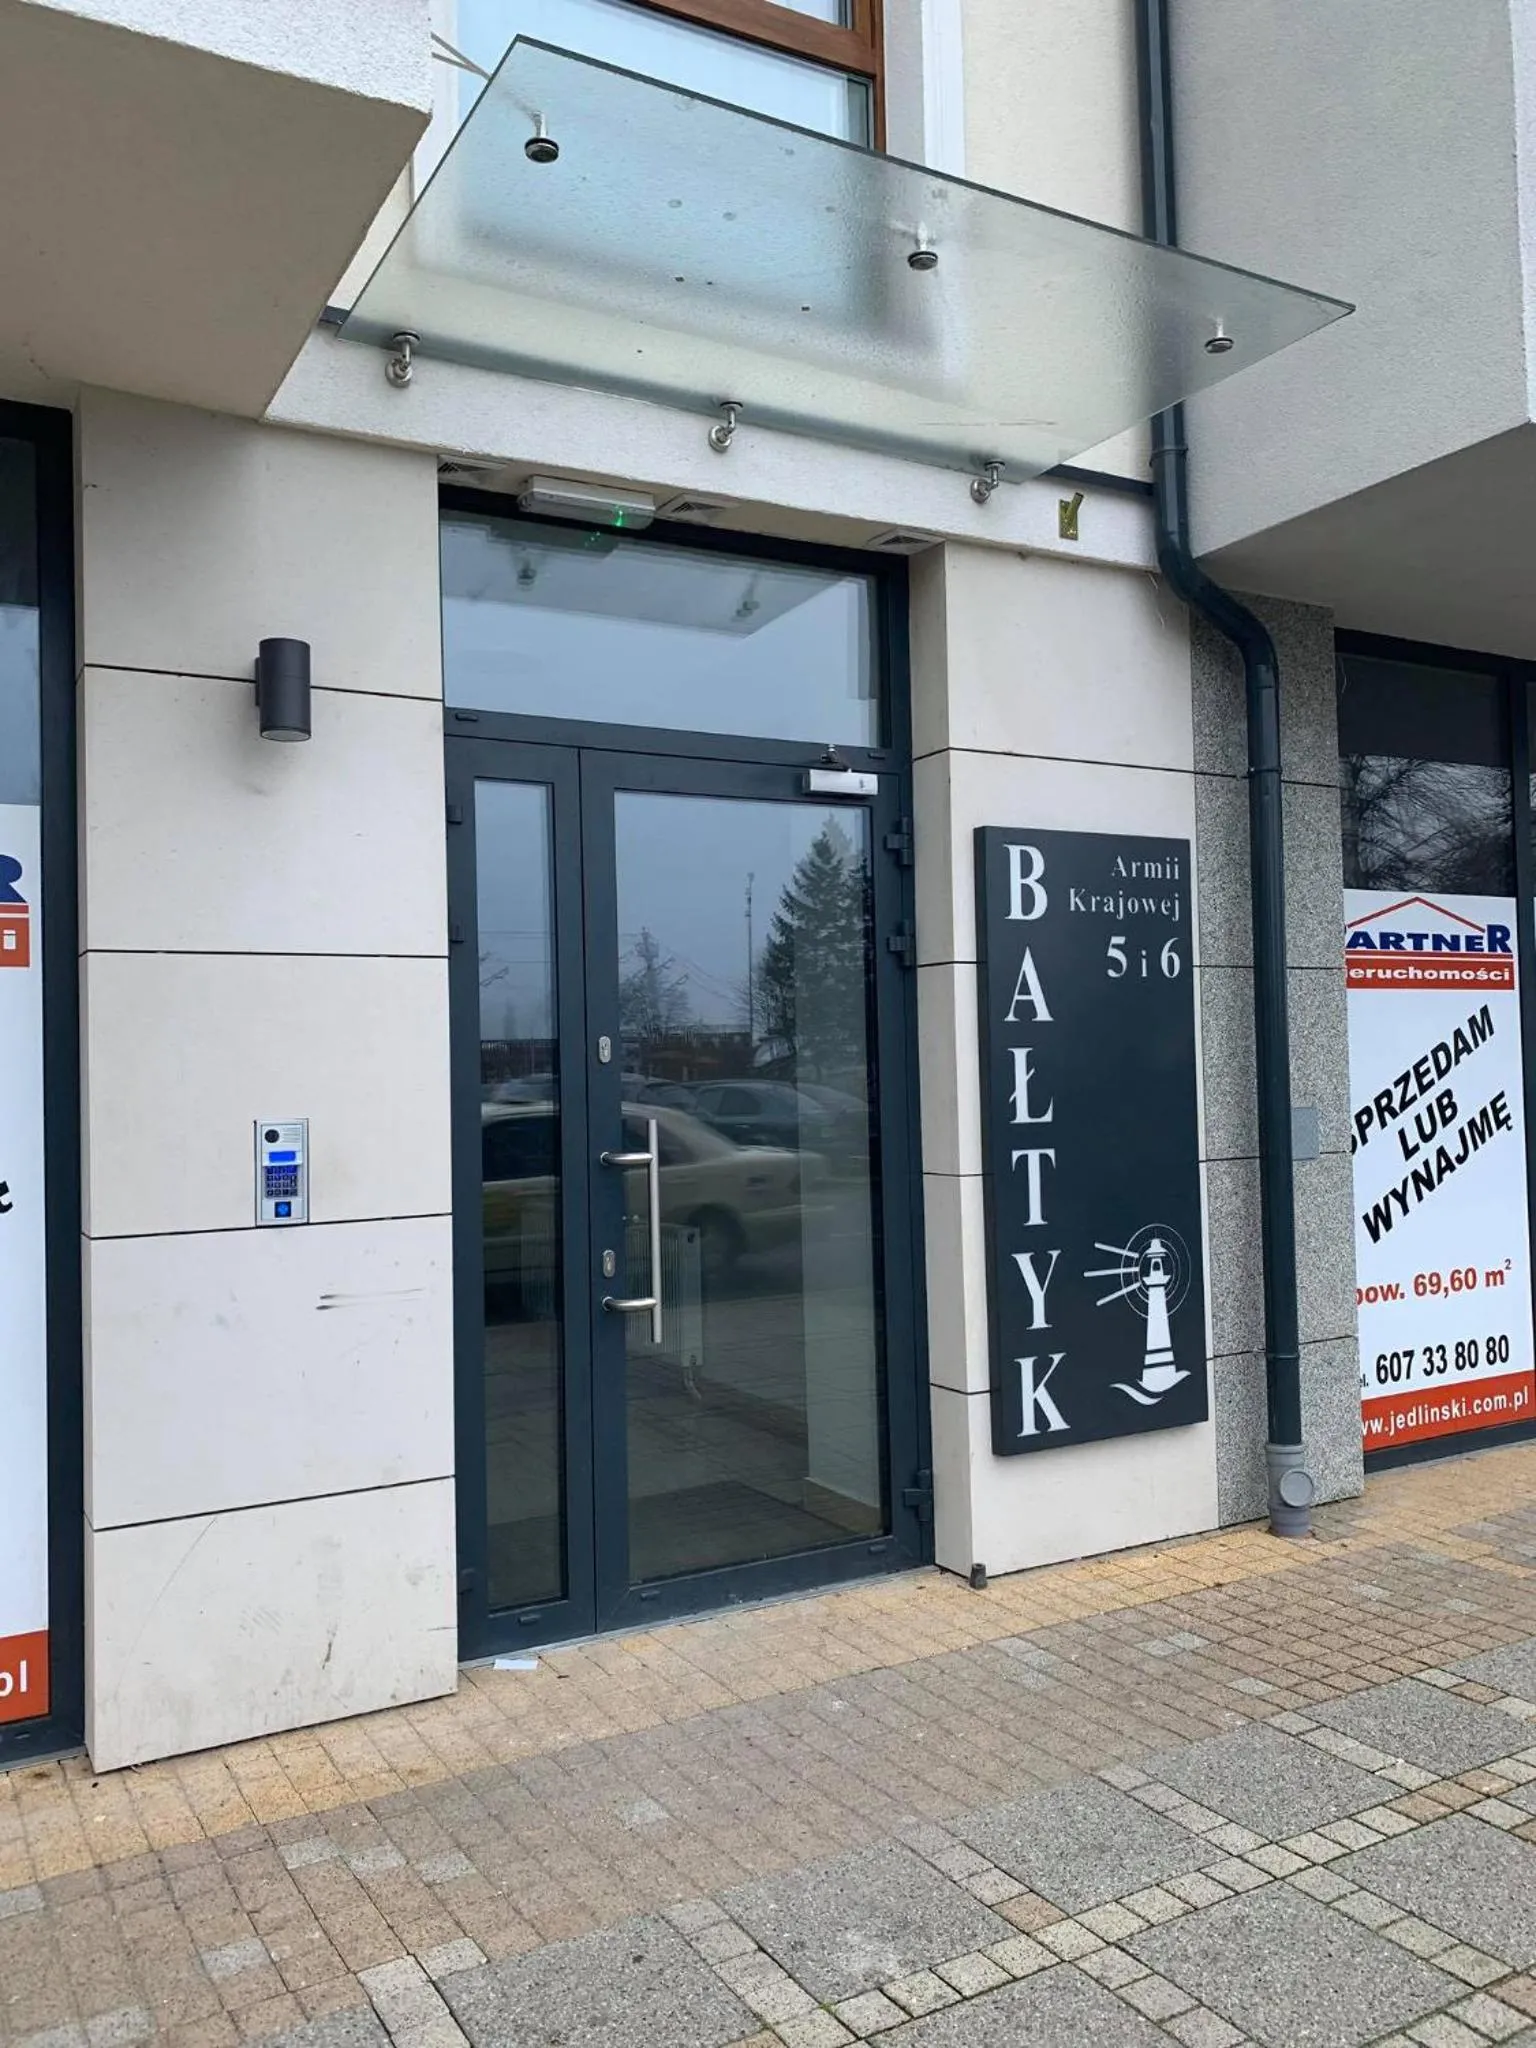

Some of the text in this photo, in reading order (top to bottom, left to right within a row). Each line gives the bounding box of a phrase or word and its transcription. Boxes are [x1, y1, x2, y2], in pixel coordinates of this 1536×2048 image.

[1111, 855, 1180, 880] Armii
[1069, 887, 1180, 921] Krajowej
[1106, 936, 1181, 978] 5 i 6
[1344, 924, 1513, 953] ARTNER
[1397, 1088, 1459, 1162] LUB
[1362, 1091, 1513, 1244] WYNAJMĘ
[1413, 1267, 1477, 1298] 69,60
[1376, 1349, 1415, 1384] 607
[1423, 1346, 1448, 1377] 33
[1455, 1340, 1479, 1372] 80
[1486, 1334, 1509, 1366] 80
